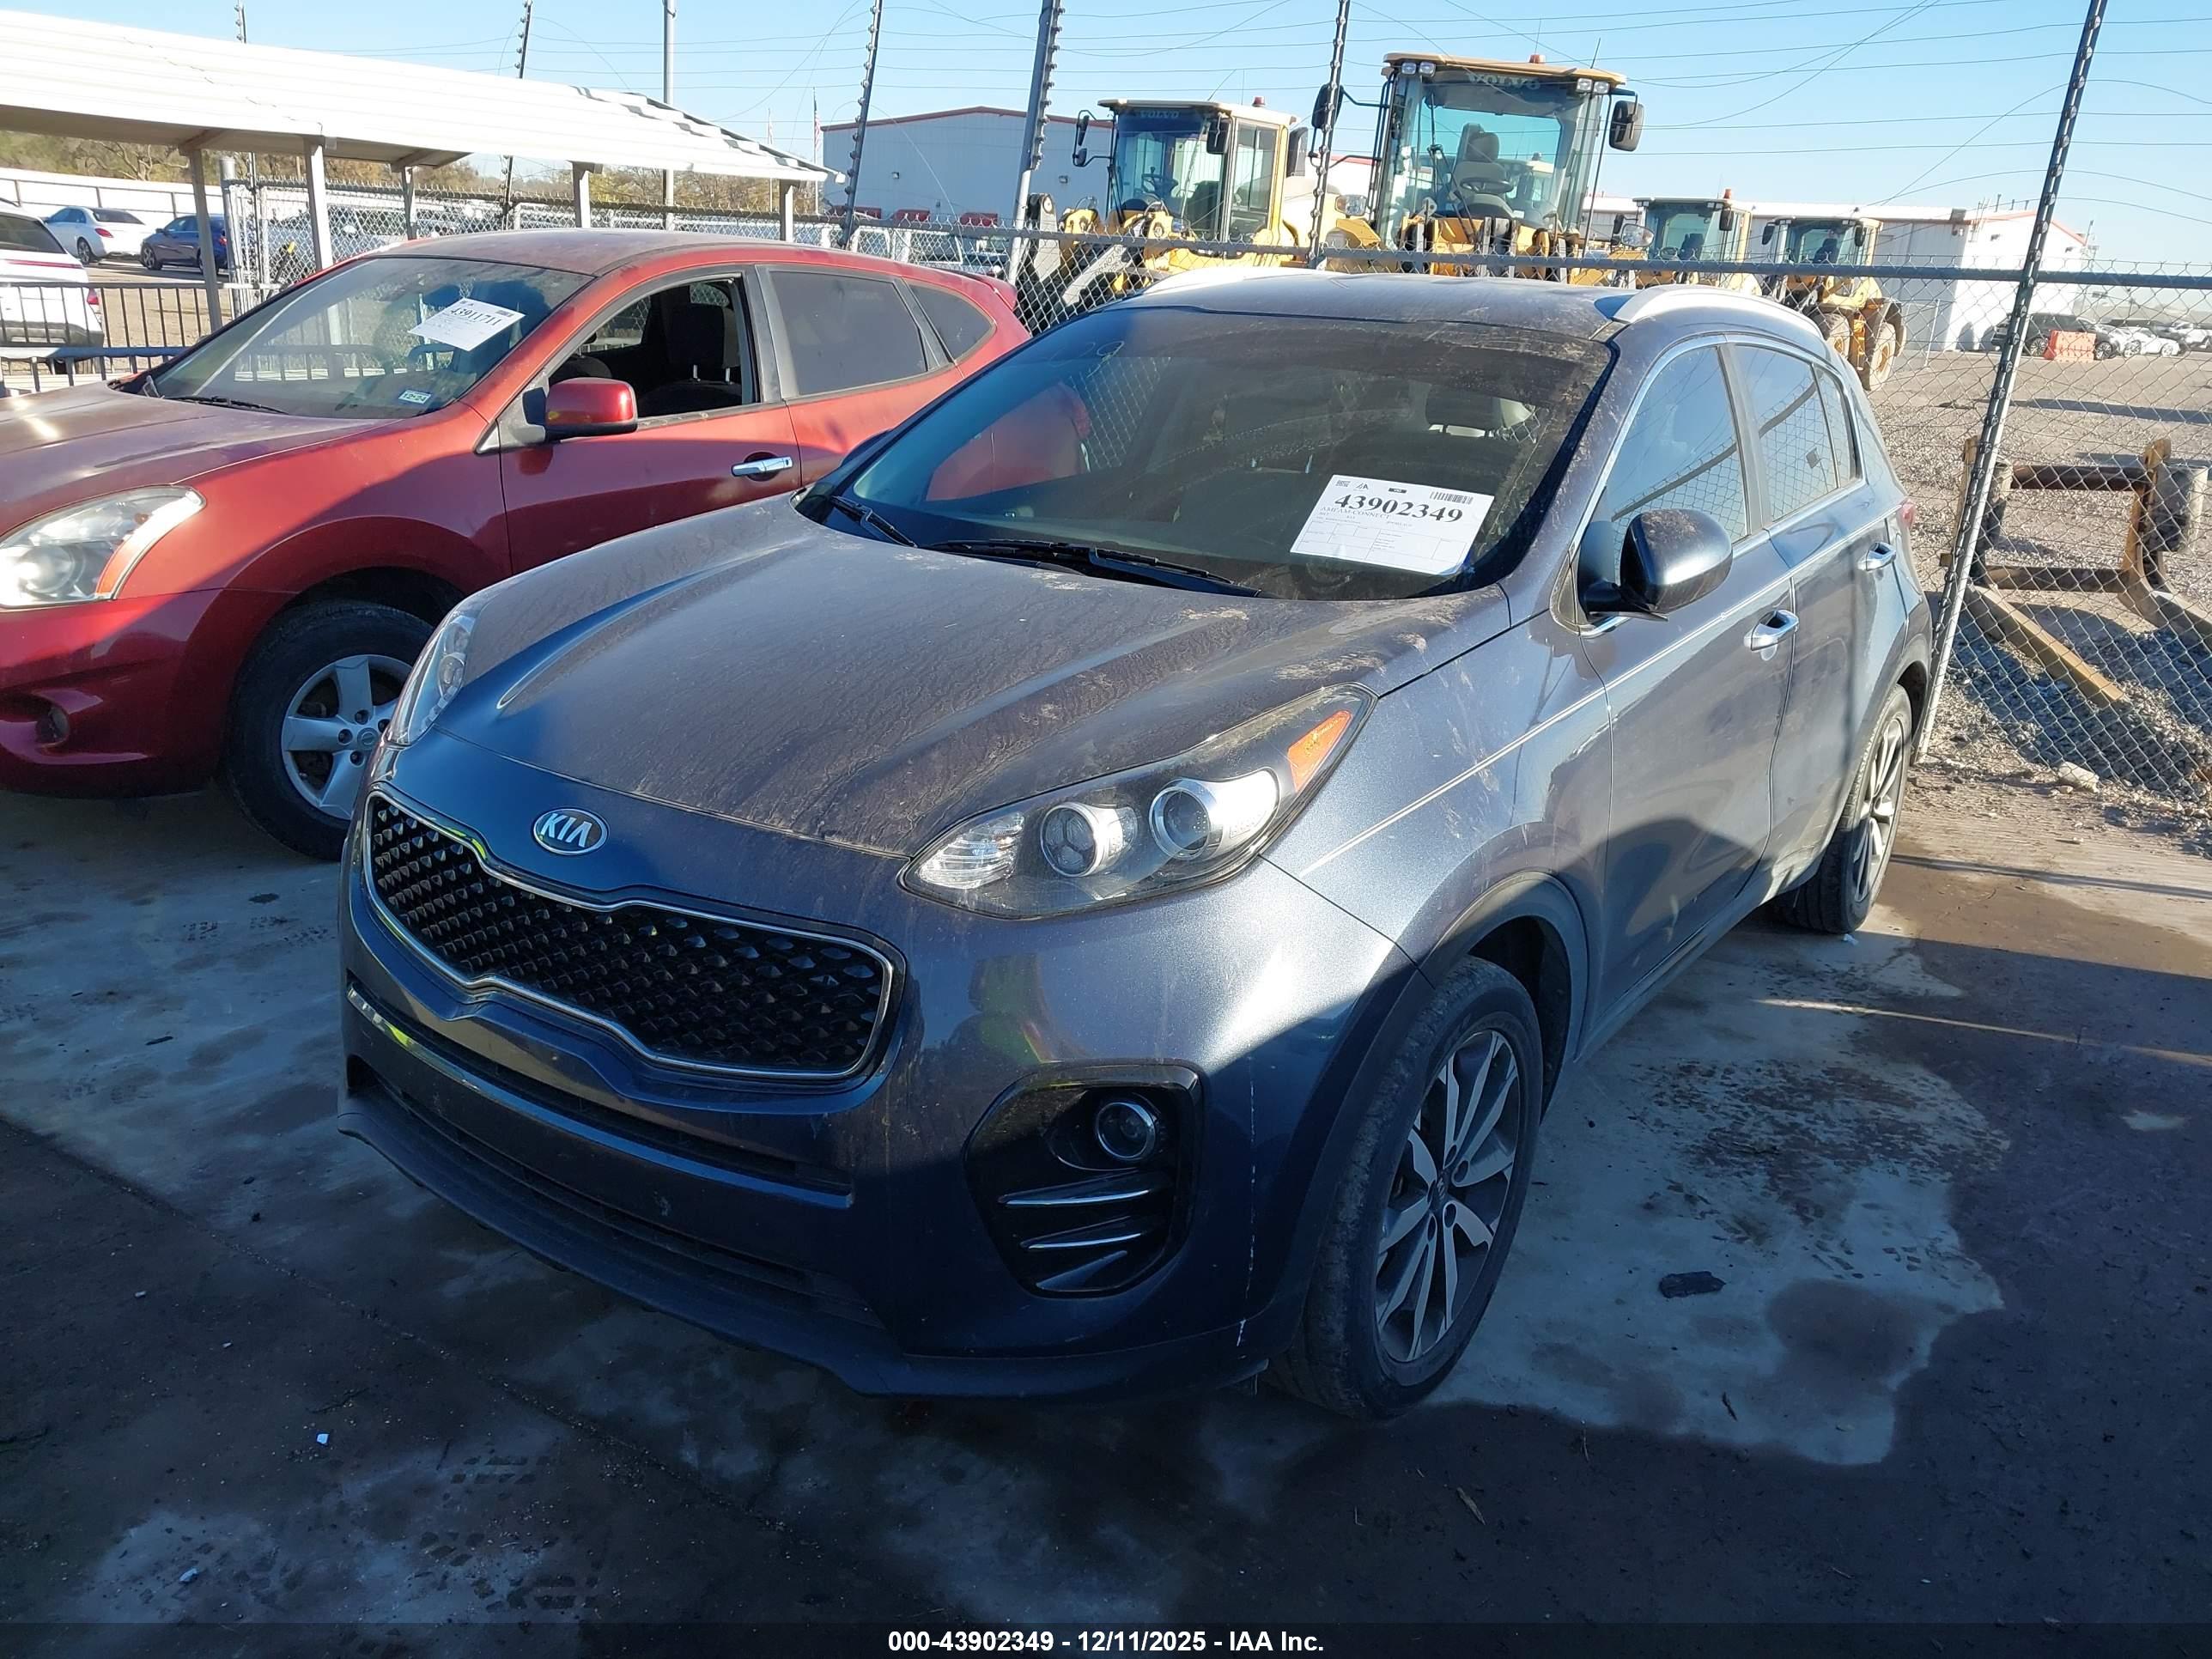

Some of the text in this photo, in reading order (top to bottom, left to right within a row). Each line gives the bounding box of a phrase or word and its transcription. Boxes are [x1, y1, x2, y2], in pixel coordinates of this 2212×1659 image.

[1464, 71, 1540, 90] VOLVO
[1139, 109, 1180, 118] VOLVO
[450, 307, 502, 326] 43911711
[1334, 494, 1463, 523] 43902349
[540, 812, 593, 848] KIA
